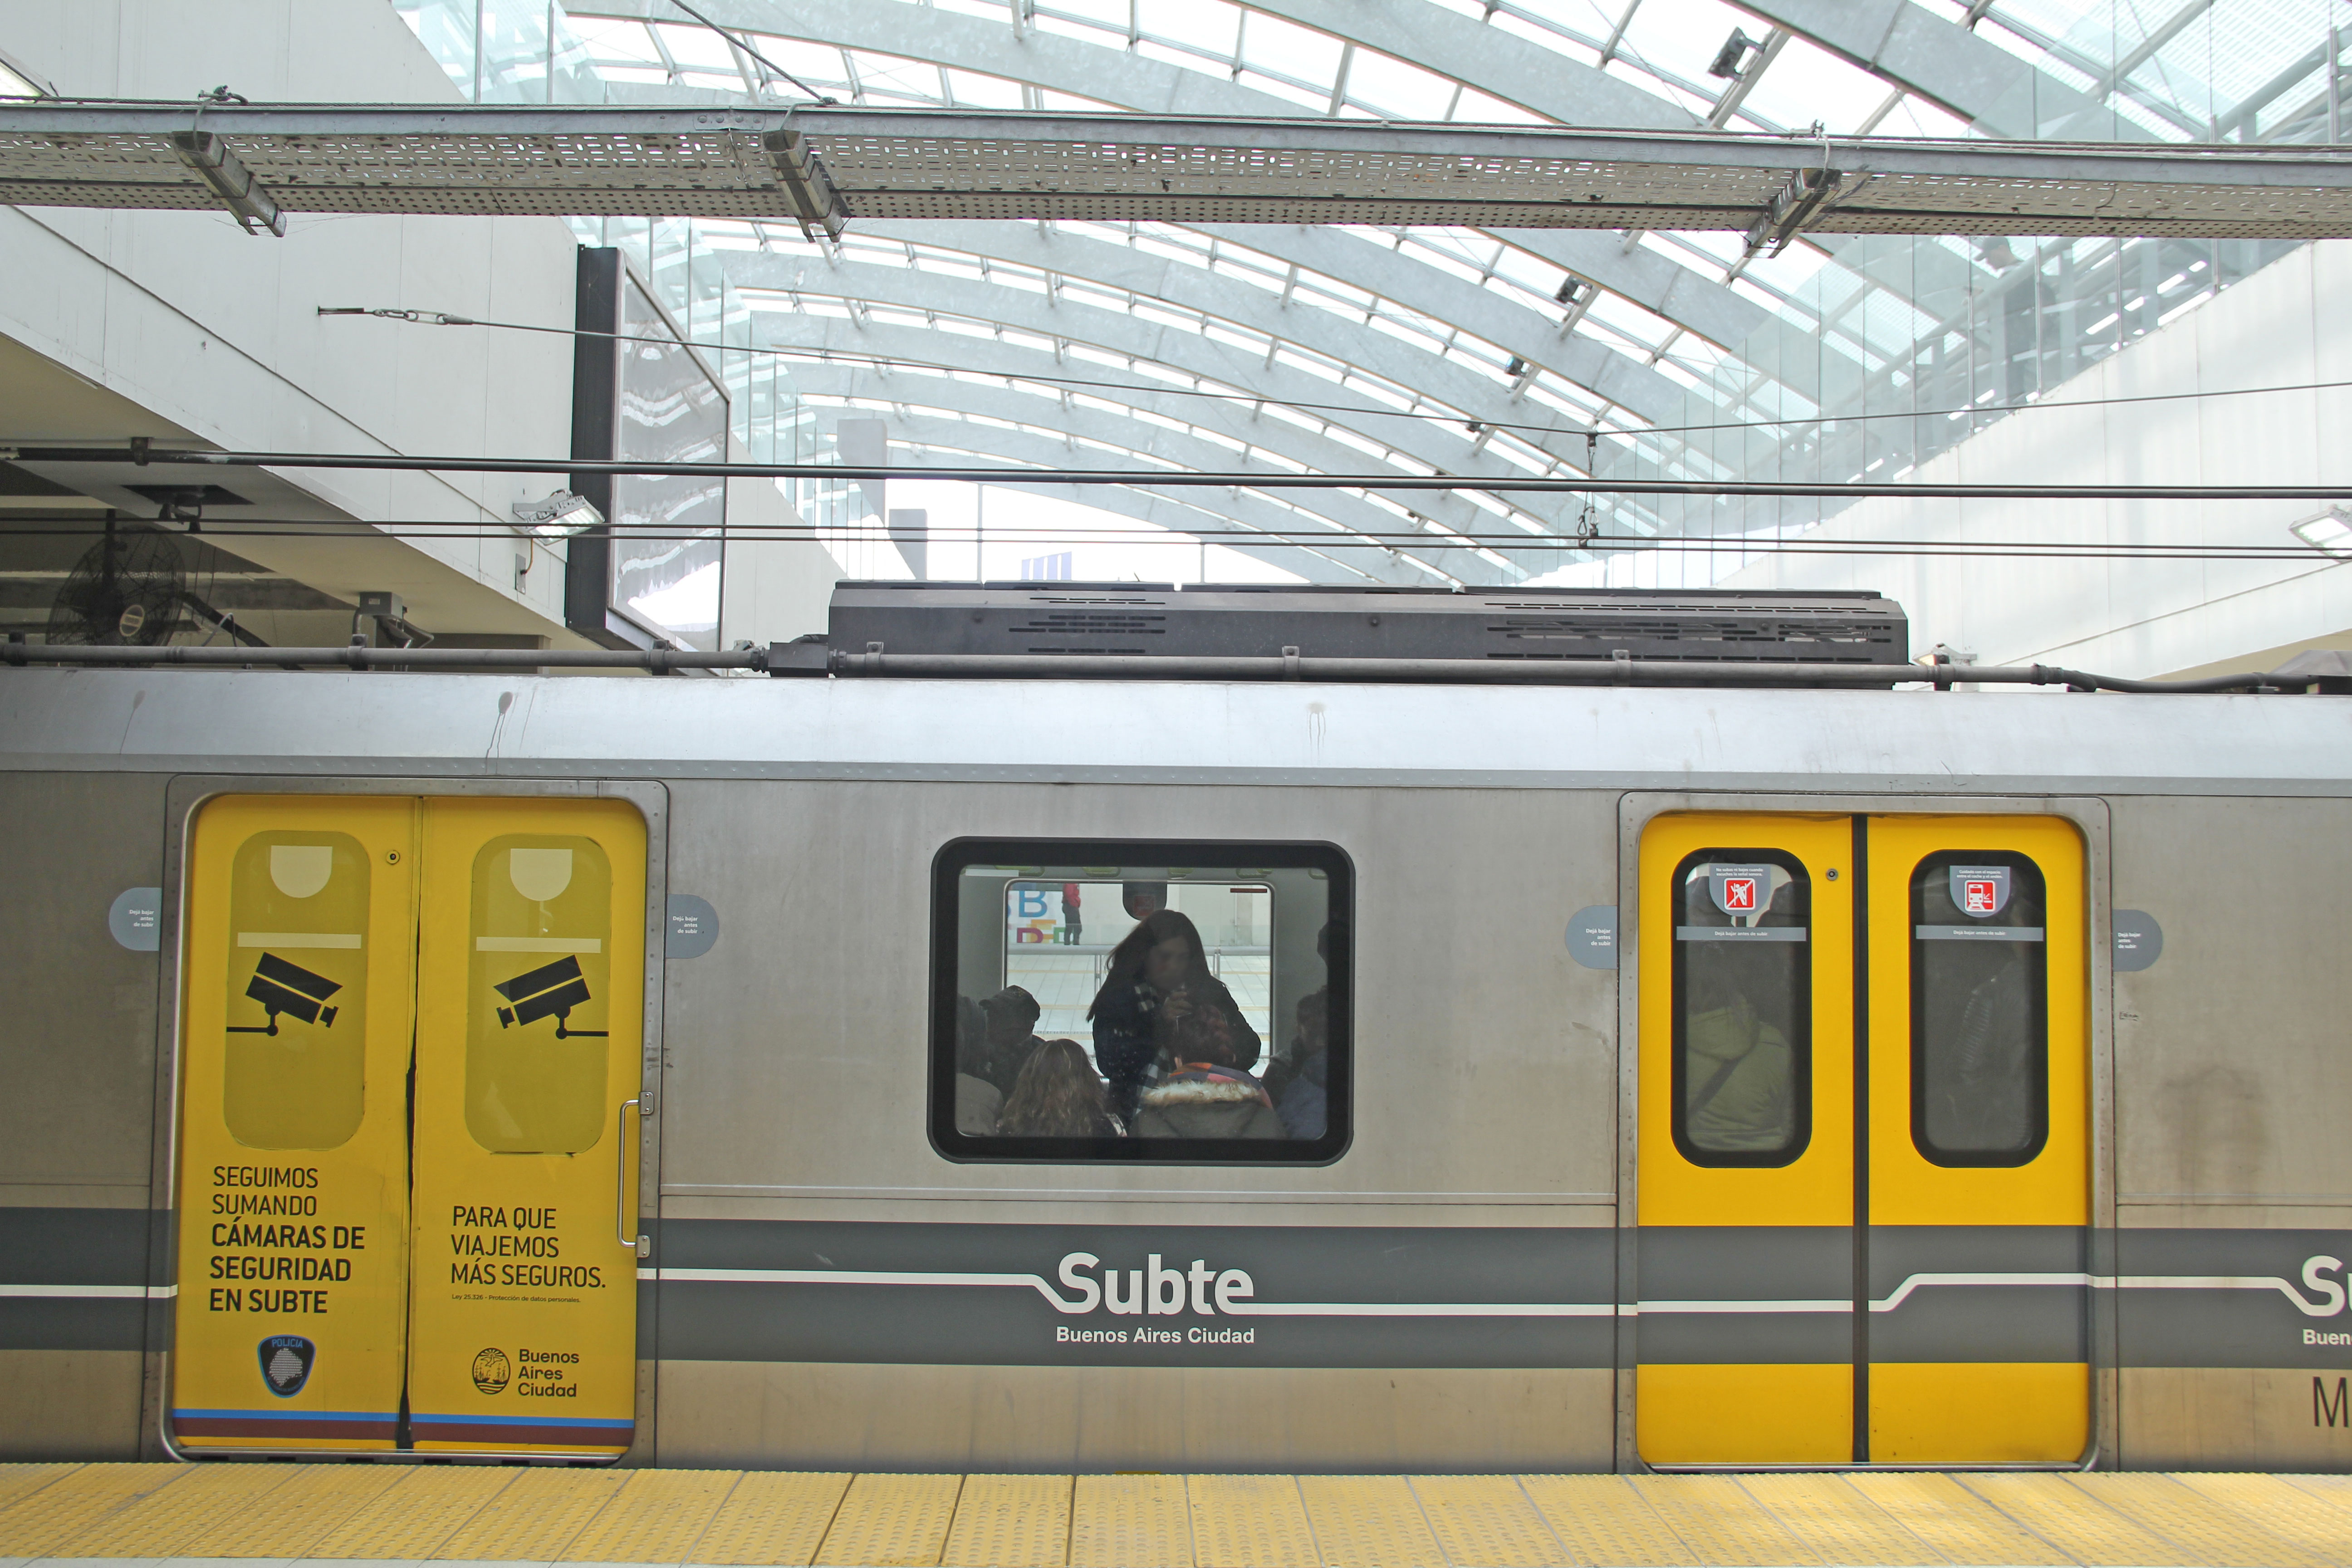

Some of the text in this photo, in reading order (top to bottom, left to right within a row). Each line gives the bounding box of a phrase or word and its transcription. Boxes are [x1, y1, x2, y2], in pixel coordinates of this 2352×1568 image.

[213, 1166, 318, 1188] SEGUIMOS
[212, 1193, 317, 1216] SUMANDO
[453, 1205, 557, 1230] PARA QUE
[212, 1216, 366, 1249] CÁMARAS DE
[451, 1234, 559, 1258] VIAJEMOS
[210, 1255, 352, 1281] SEGURIDAD
[451, 1257, 606, 1288] MÁS SEGUROS.
[1058, 1251, 1254, 1315] Subte
[2301, 1254, 2352, 1317] S
[210, 1288, 328, 1313] EN SUBTE
[1056, 1325, 1255, 1343] Buenos Aires Ciudad
[2302, 1328, 2352, 1346] Buen
[519, 1348, 580, 1364] Buenos
[518, 1365, 564, 1380] Aires
[518, 1382, 577, 1397] Ciudad
